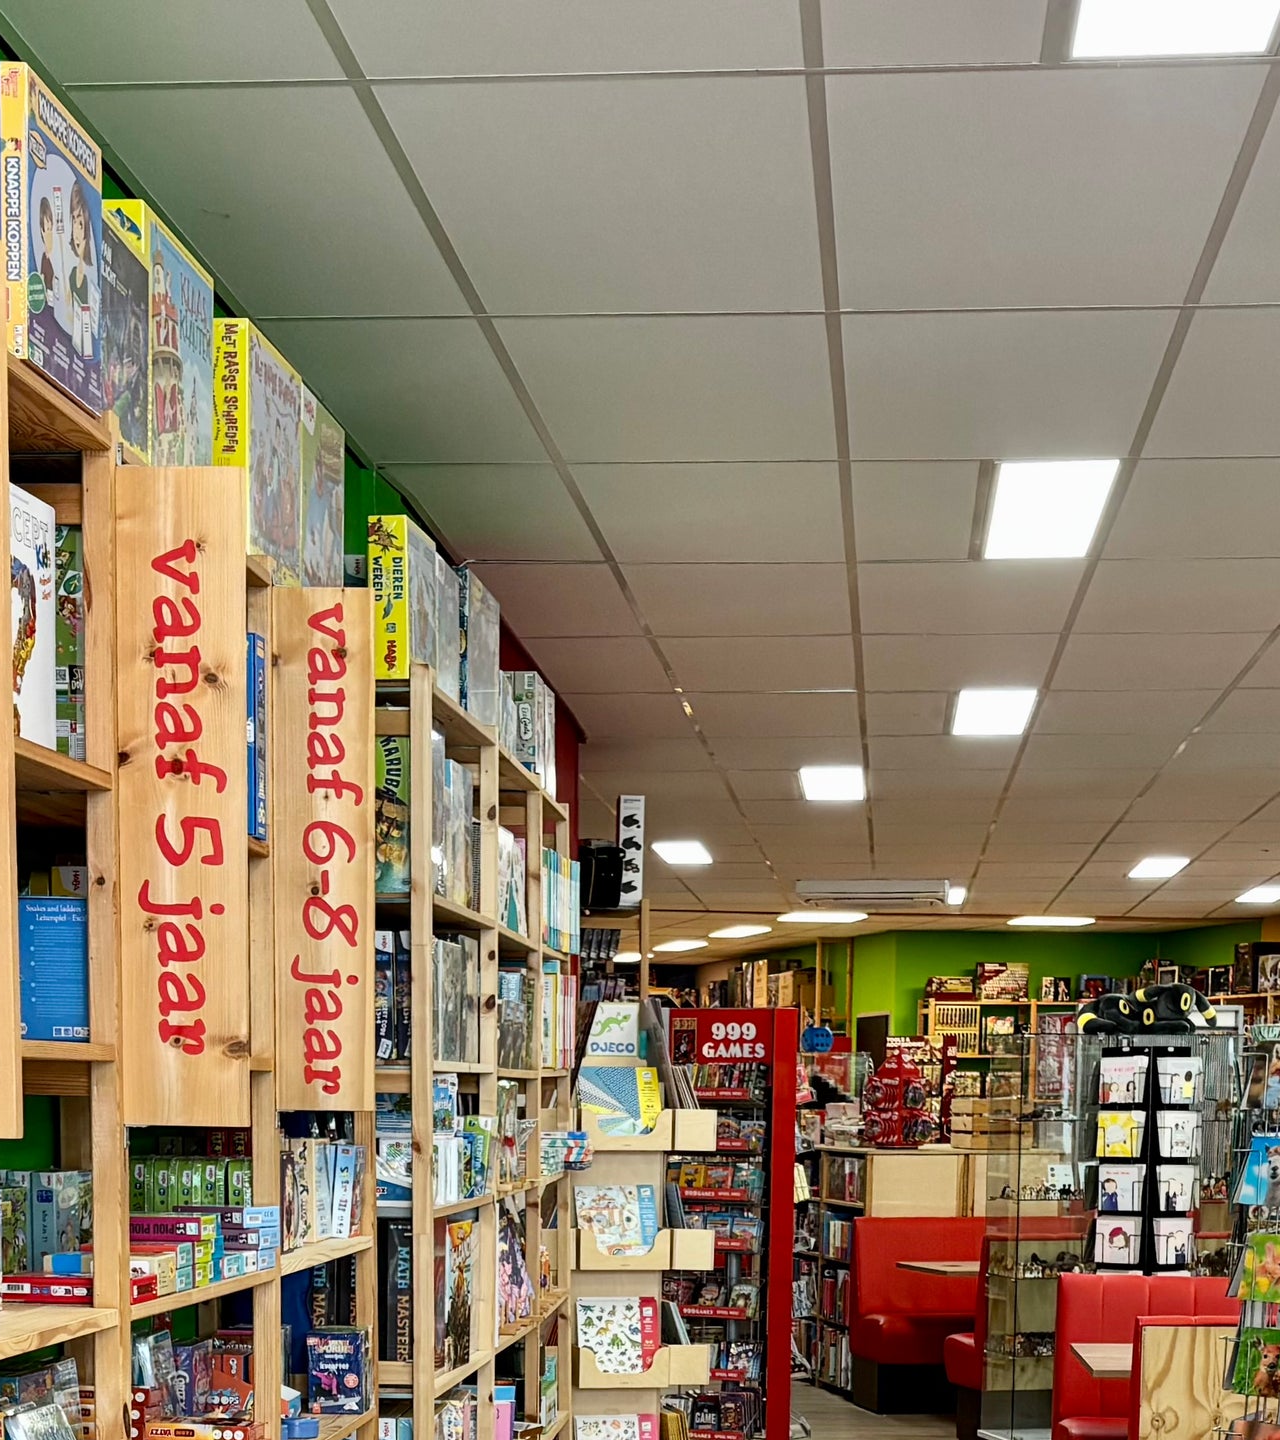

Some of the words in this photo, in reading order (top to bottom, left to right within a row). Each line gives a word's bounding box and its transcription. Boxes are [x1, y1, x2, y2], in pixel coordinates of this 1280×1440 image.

[38, 91, 69, 145] KNAPPE
[66, 129, 97, 180] KOPPEN
[6, 156, 20, 219] KNAPPE
[7, 220, 21, 281] KOPPEN
[222, 323, 239, 348] MET
[392, 557, 403, 600] DIEREN
[150, 538, 229, 794] vanaf
[384, 639, 397, 671] HABA
[306, 602, 364, 806] vanaf
[154, 813, 224, 868] 5
[302, 820, 359, 948] 6-8
[138, 879, 226, 1056] jaar
[290, 954, 360, 1096] jaar
[590, 1041, 635, 1056] DJECO
[702, 1042, 766, 1059] GAMES
[711, 1022, 757, 1041] 999
[397, 1245, 409, 1289] MATH
[695, 1412, 716, 1425] GAME
